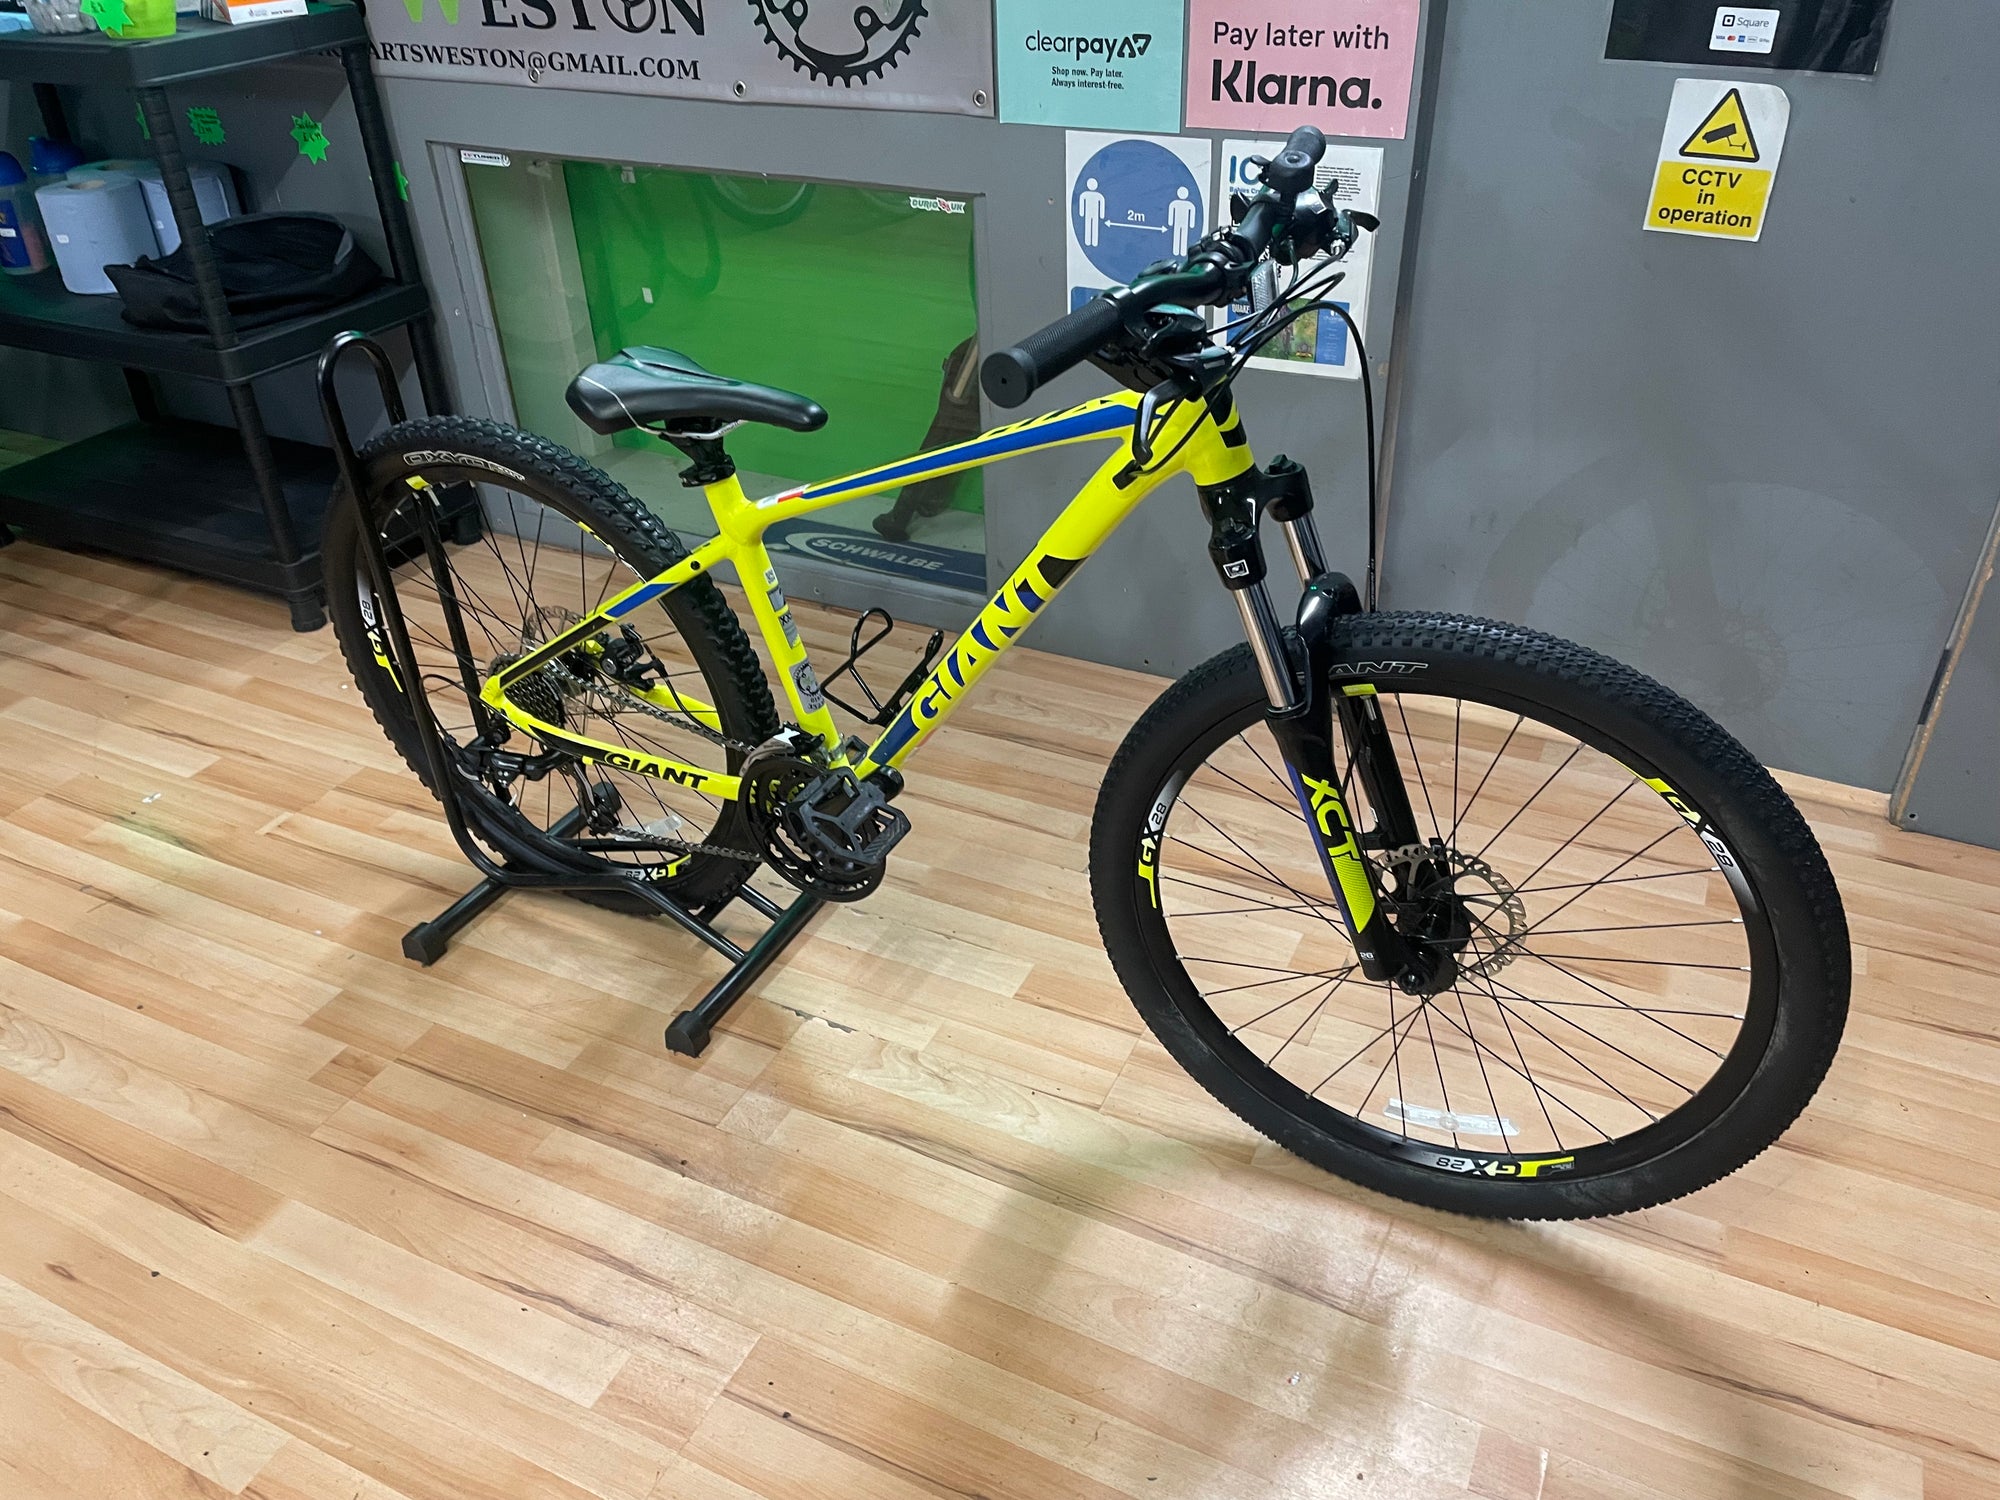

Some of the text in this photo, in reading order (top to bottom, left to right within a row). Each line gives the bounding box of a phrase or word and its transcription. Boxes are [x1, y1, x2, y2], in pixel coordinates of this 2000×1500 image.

[1737, 17, 1769, 28] Square
[1026, 30, 1117, 62] clearpay
[1214, 22, 1389, 50] Pay later with
[369, 41, 701, 80] ARTSWESTON@GMAIL.COM
[1052, 66, 1069, 77] Shop
[1091, 68, 1103, 78] Pay
[1105, 69, 1124, 78] later.
[1052, 78, 1075, 88] Always
[1212, 59, 1382, 109] Klarna.
[1682, 168, 1743, 189] CCTV
[1697, 189, 1715, 206] in
[1127, 210, 1145, 222] 2m
[1658, 206, 1752, 229] operation
[812, 538, 943, 570] SCHWALBE
[911, 554, 1049, 732] GIANT
[1328, 661, 1428, 674] ANT
[605, 753, 708, 789] GIANT
[1302, 773, 1362, 863] XCT
